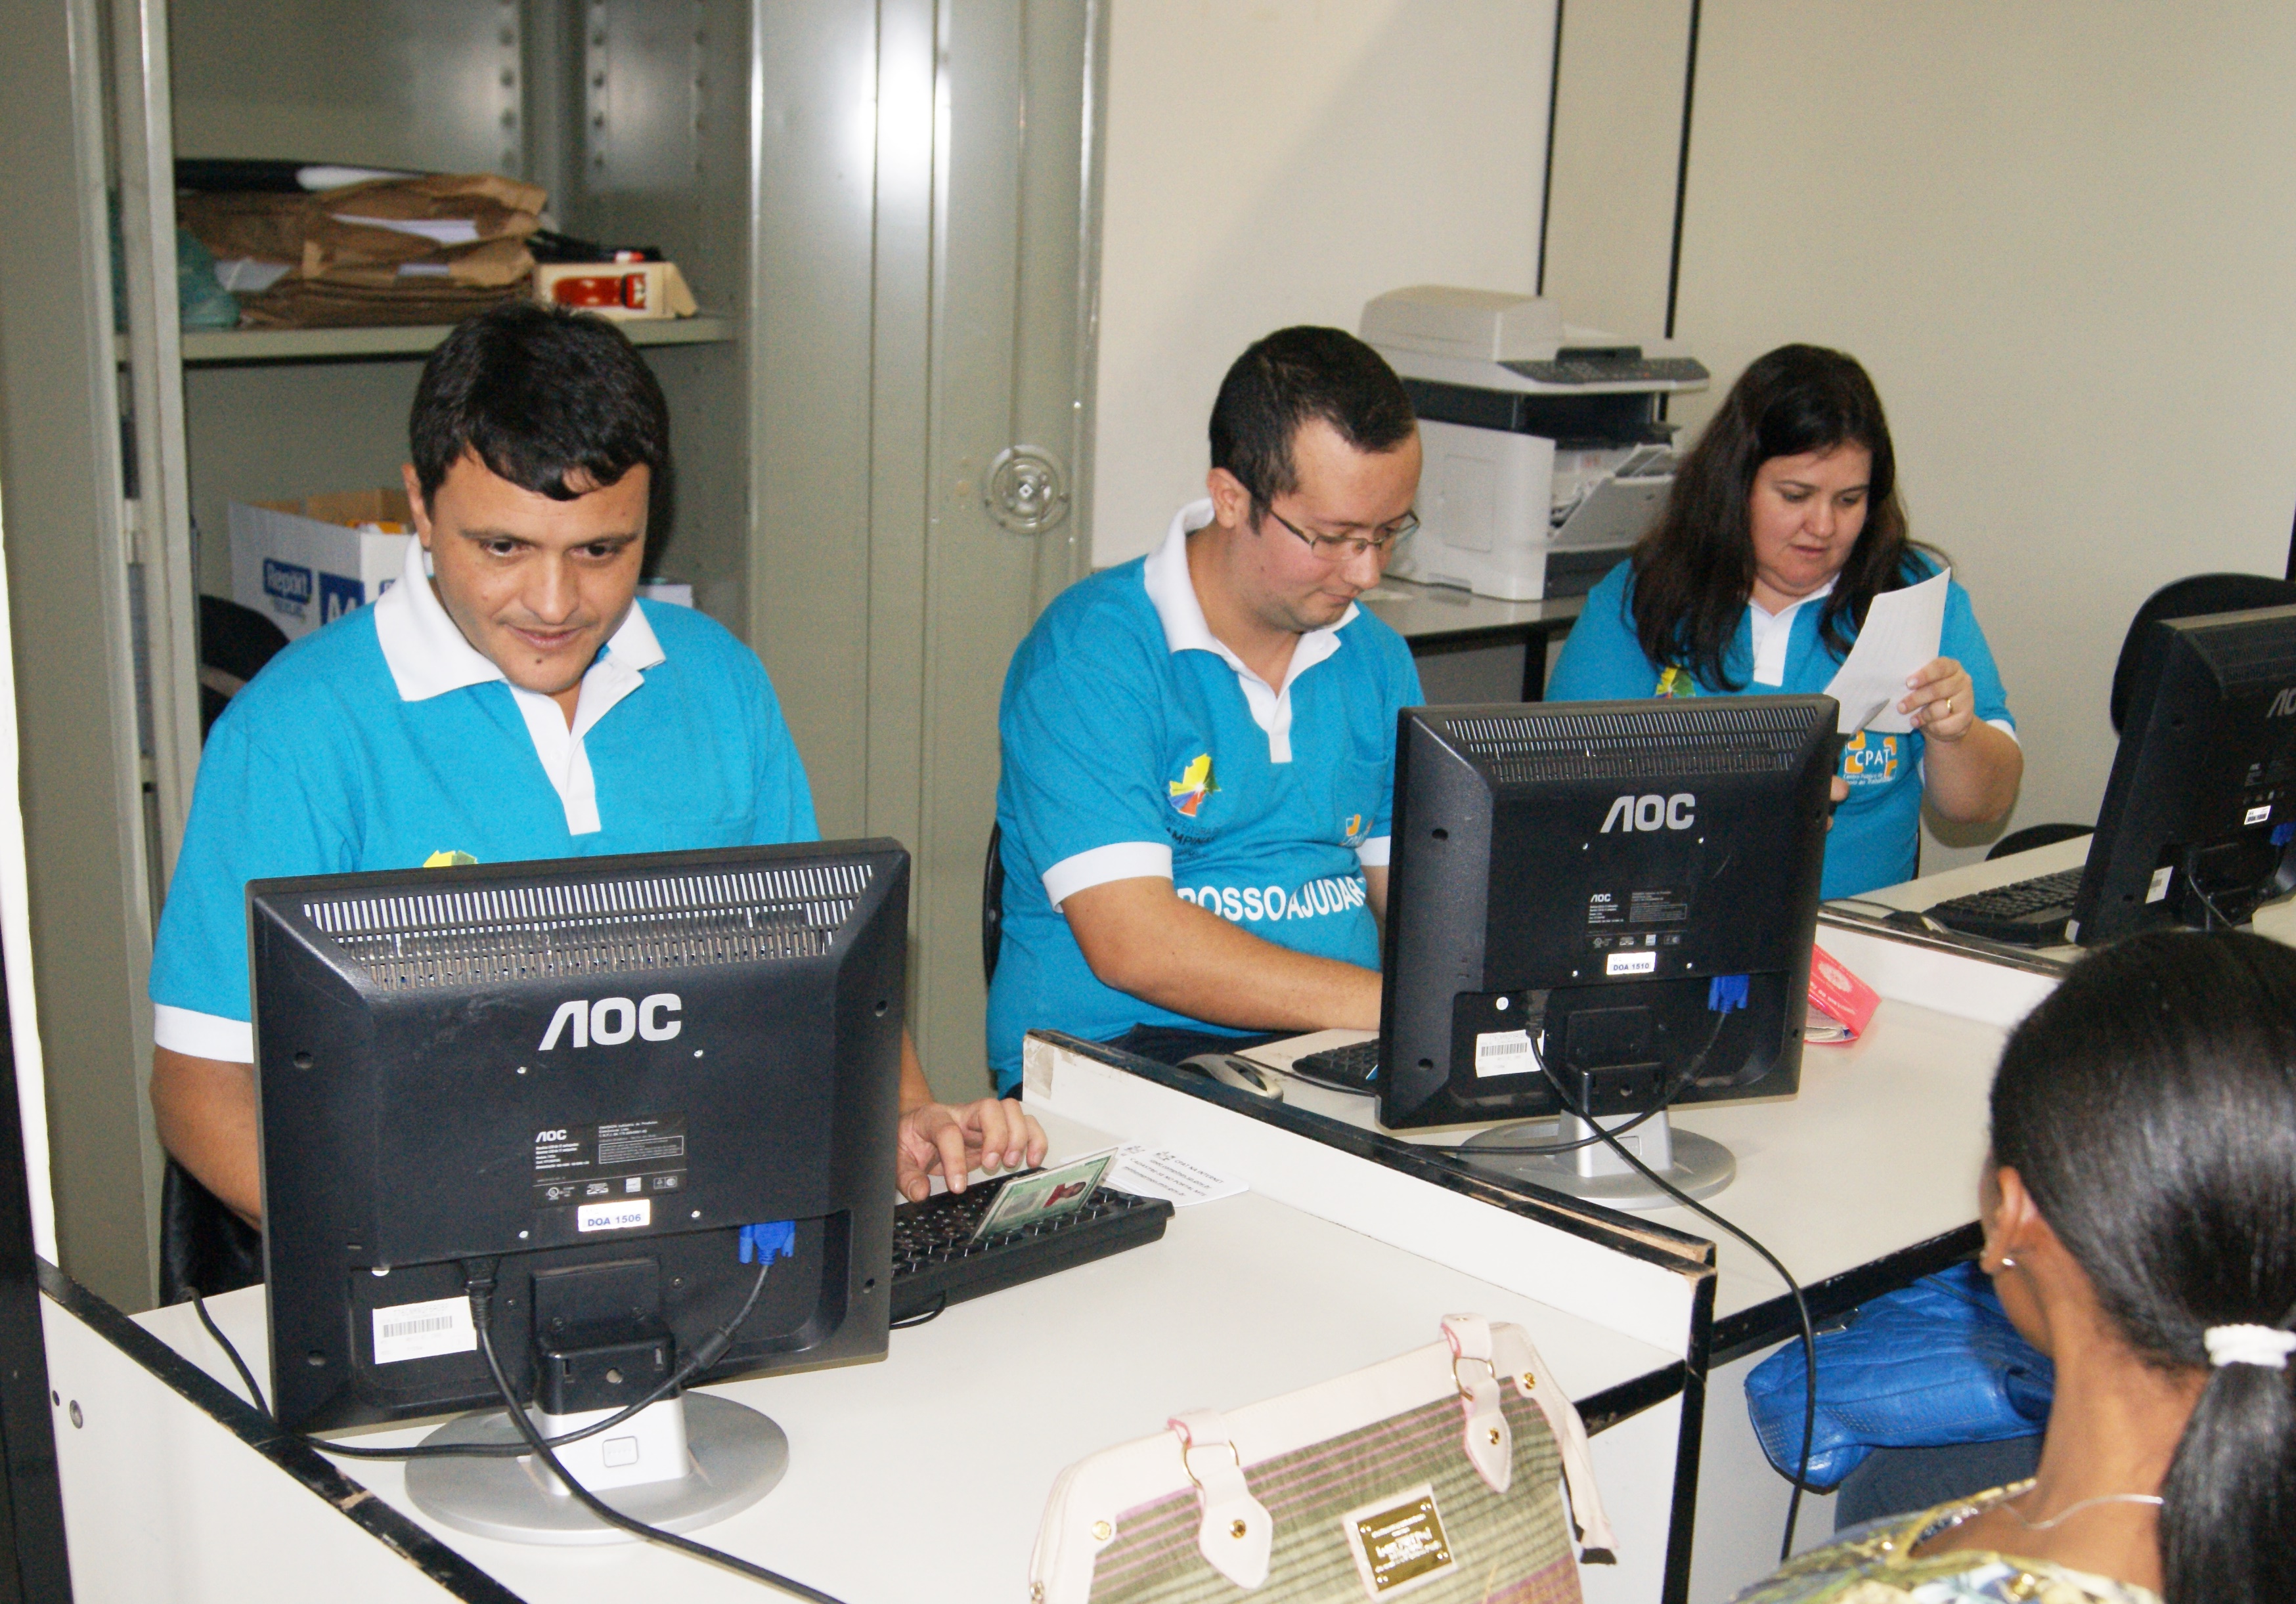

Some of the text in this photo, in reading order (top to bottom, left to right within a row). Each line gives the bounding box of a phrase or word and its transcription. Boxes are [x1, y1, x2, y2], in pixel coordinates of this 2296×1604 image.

[2266, 687, 2296, 718] AO
[1855, 748, 1890, 766] CPAT
[1600, 793, 1696, 833] AOC
[1590, 894, 1611, 903] AOC
[539, 993, 682, 1051] AOC
[535, 1129, 567, 1142] AOC
[1197, 1169, 1224, 1184] INTERNET
[588, 1213, 641, 1226] DOA 1506
